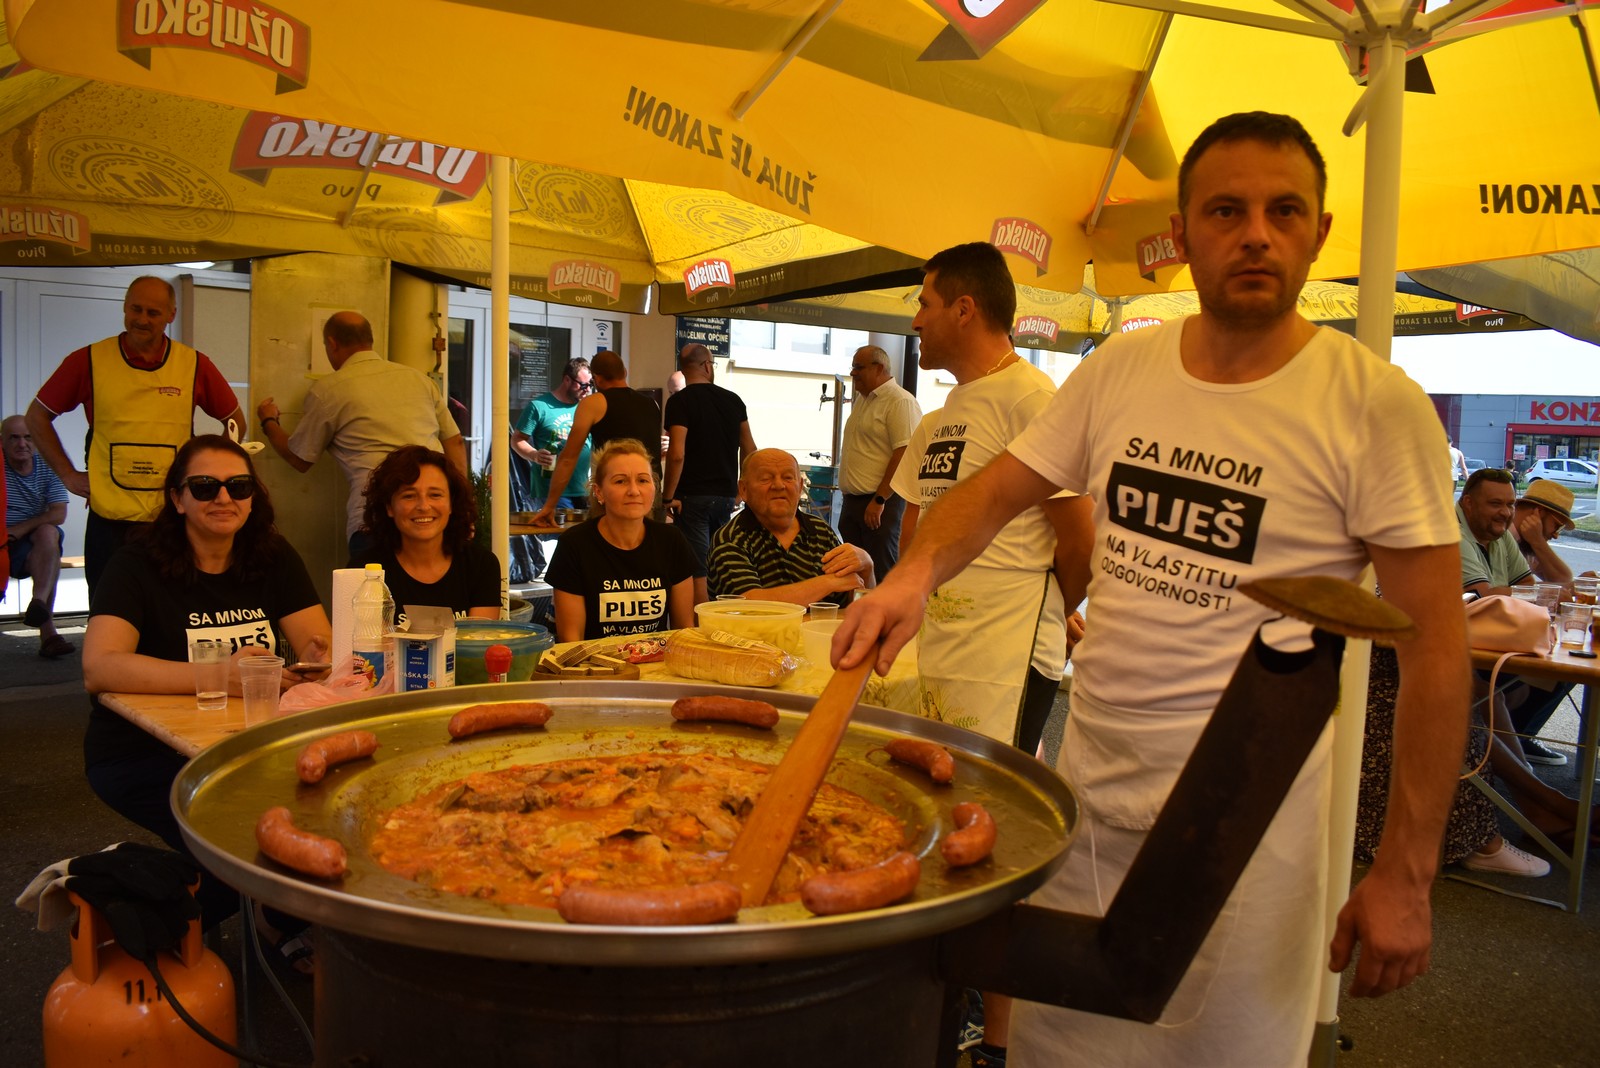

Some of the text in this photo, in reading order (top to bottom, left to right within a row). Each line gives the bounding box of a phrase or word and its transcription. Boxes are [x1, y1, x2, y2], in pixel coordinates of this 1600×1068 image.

[940, 425, 967, 439] MNOM
[919, 446, 957, 474] PIJEŠ
[1125, 437, 1263, 487] SA MNOM
[1117, 484, 1246, 549] PIJEŠ
[1106, 534, 1238, 589] NA VLASTITU
[603, 577, 661, 590] SA MNOM
[1101, 556, 1231, 612] ODGOVORNOST!
[189, 607, 266, 626] SA MNOM
[605, 594, 662, 618] PIJEŠ
[197, 626, 270, 657] JEŠ
[603, 625, 616, 635] NA
[619, 621, 660, 634] VLASTITU
